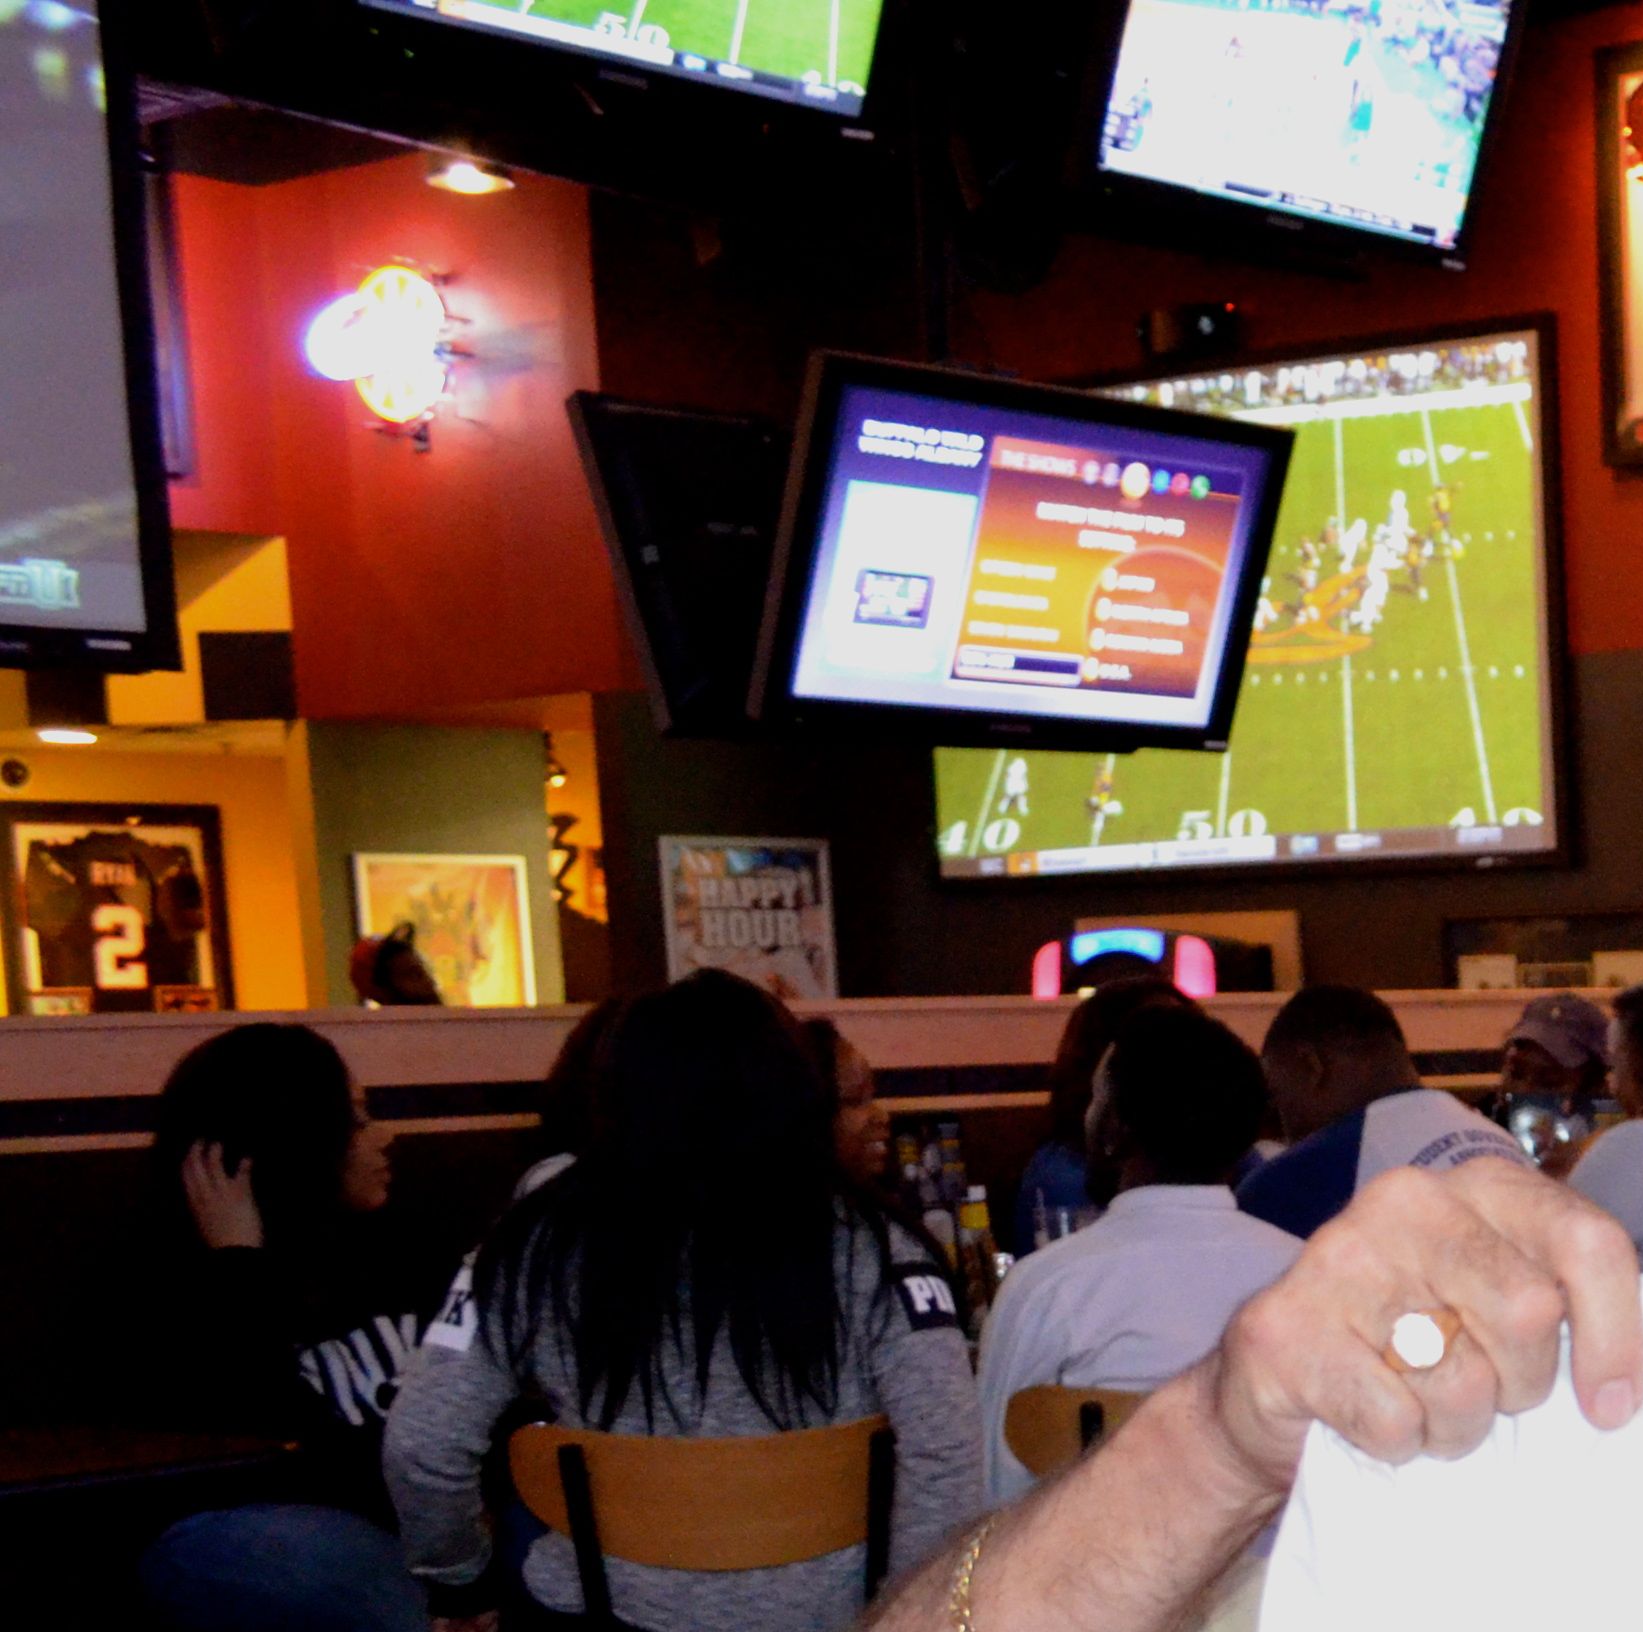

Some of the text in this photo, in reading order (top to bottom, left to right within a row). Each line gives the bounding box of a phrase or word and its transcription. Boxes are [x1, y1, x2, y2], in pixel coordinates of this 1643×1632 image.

[937, 818, 1021, 855] 40
[1178, 809, 1268, 841] 50
[92, 905, 149, 990] 2
[702, 909, 800, 948] HOUR
